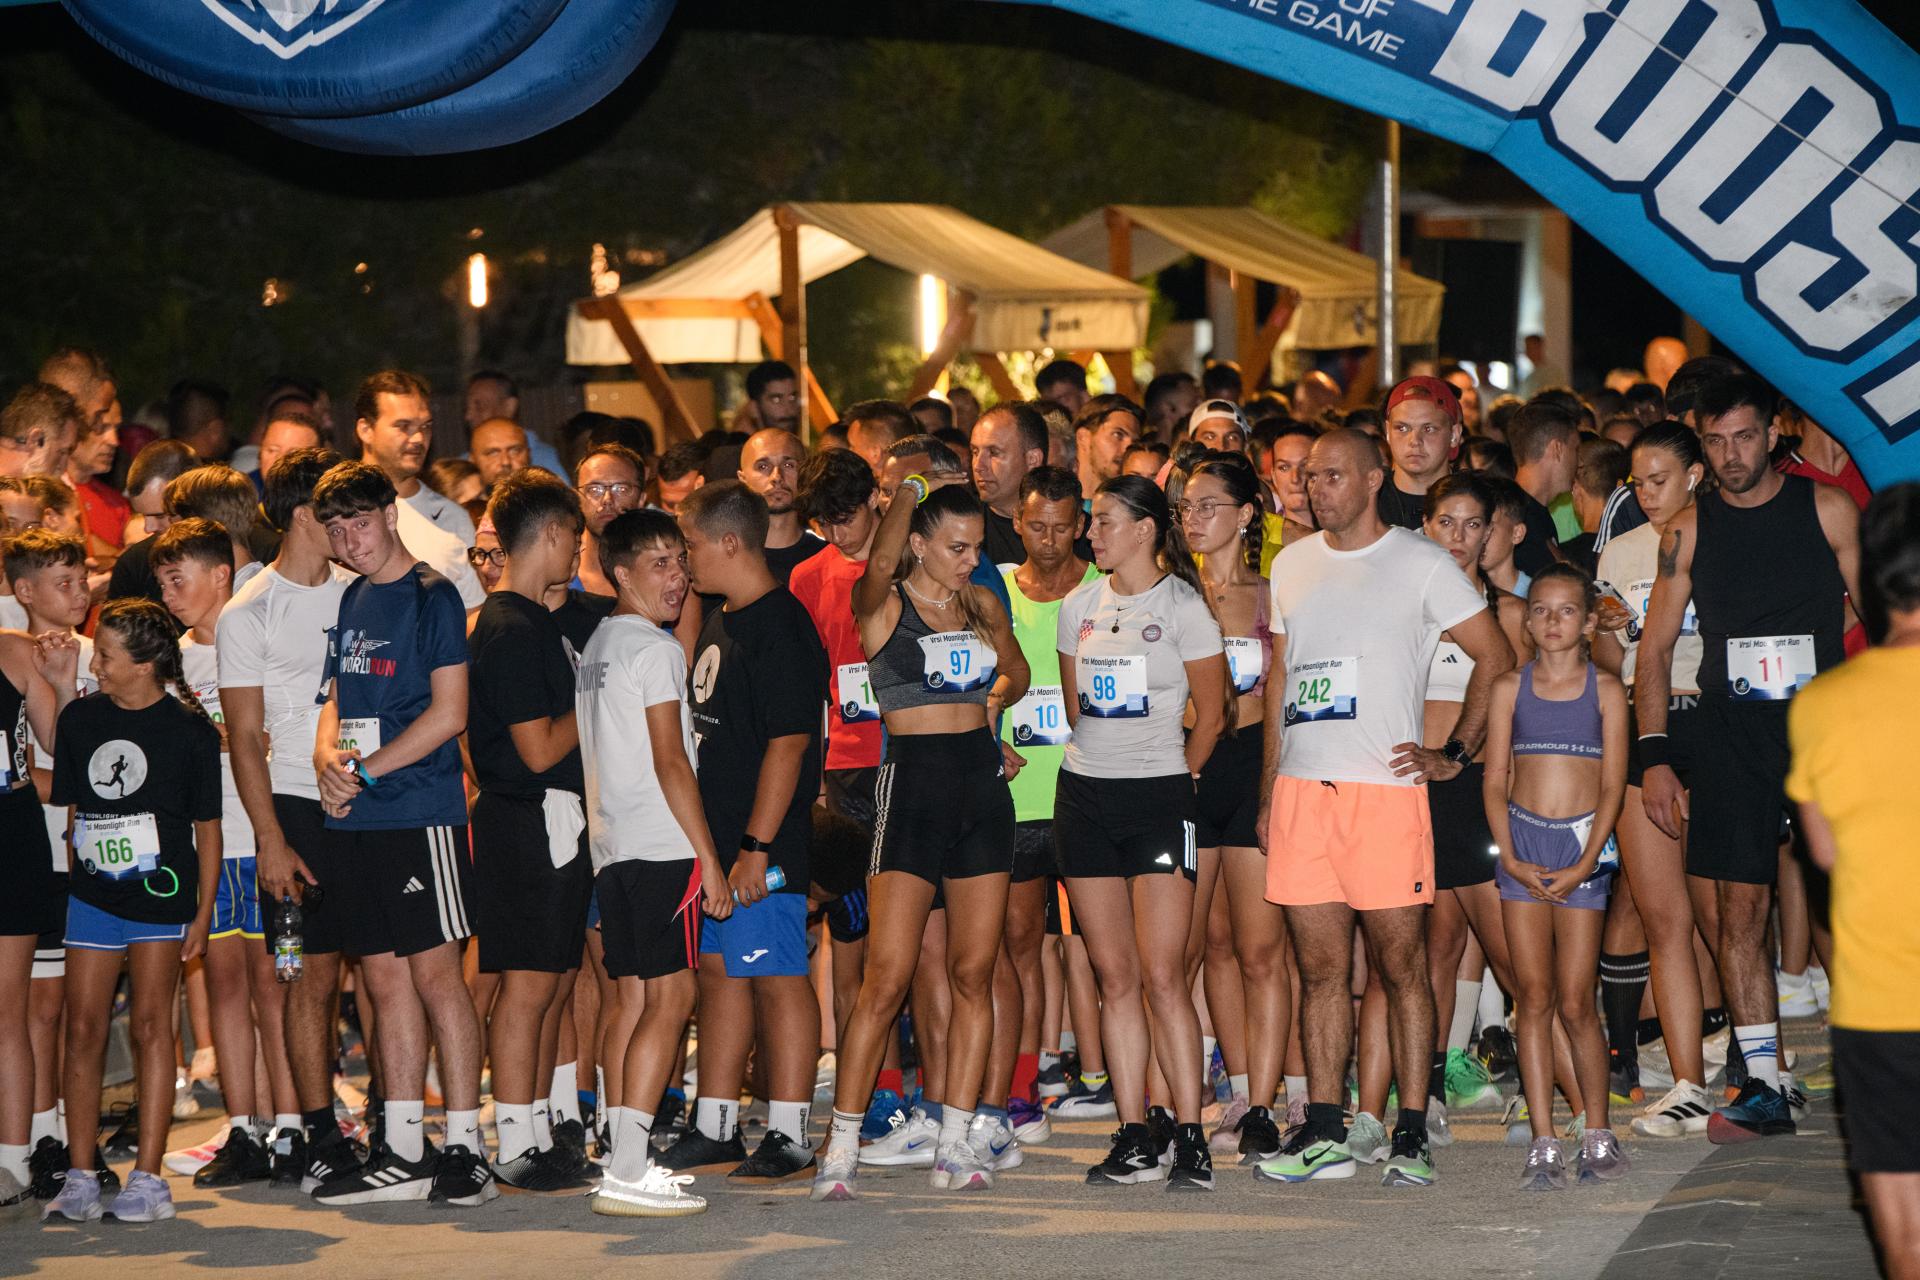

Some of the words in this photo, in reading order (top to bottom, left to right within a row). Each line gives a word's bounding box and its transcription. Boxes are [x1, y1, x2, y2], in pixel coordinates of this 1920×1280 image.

[1287, 2, 1405, 60] GAME
[1430, 0, 1920, 426] BOOS
[943, 631, 970, 642] Moonlight
[1235, 639, 1249, 647] Run
[950, 649, 971, 676] 97
[1090, 657, 1117, 667] Moonlight
[1119, 658, 1132, 666] Run
[1301, 660, 1330, 671] Moonlight
[1329, 659, 1343, 668] Run
[1093, 675, 1116, 700] 98
[1298, 677, 1331, 705] 242
[93, 820, 126, 831] Moonlight
[1516, 812, 1547, 828] UNDER
[95, 837, 133, 865] 166
